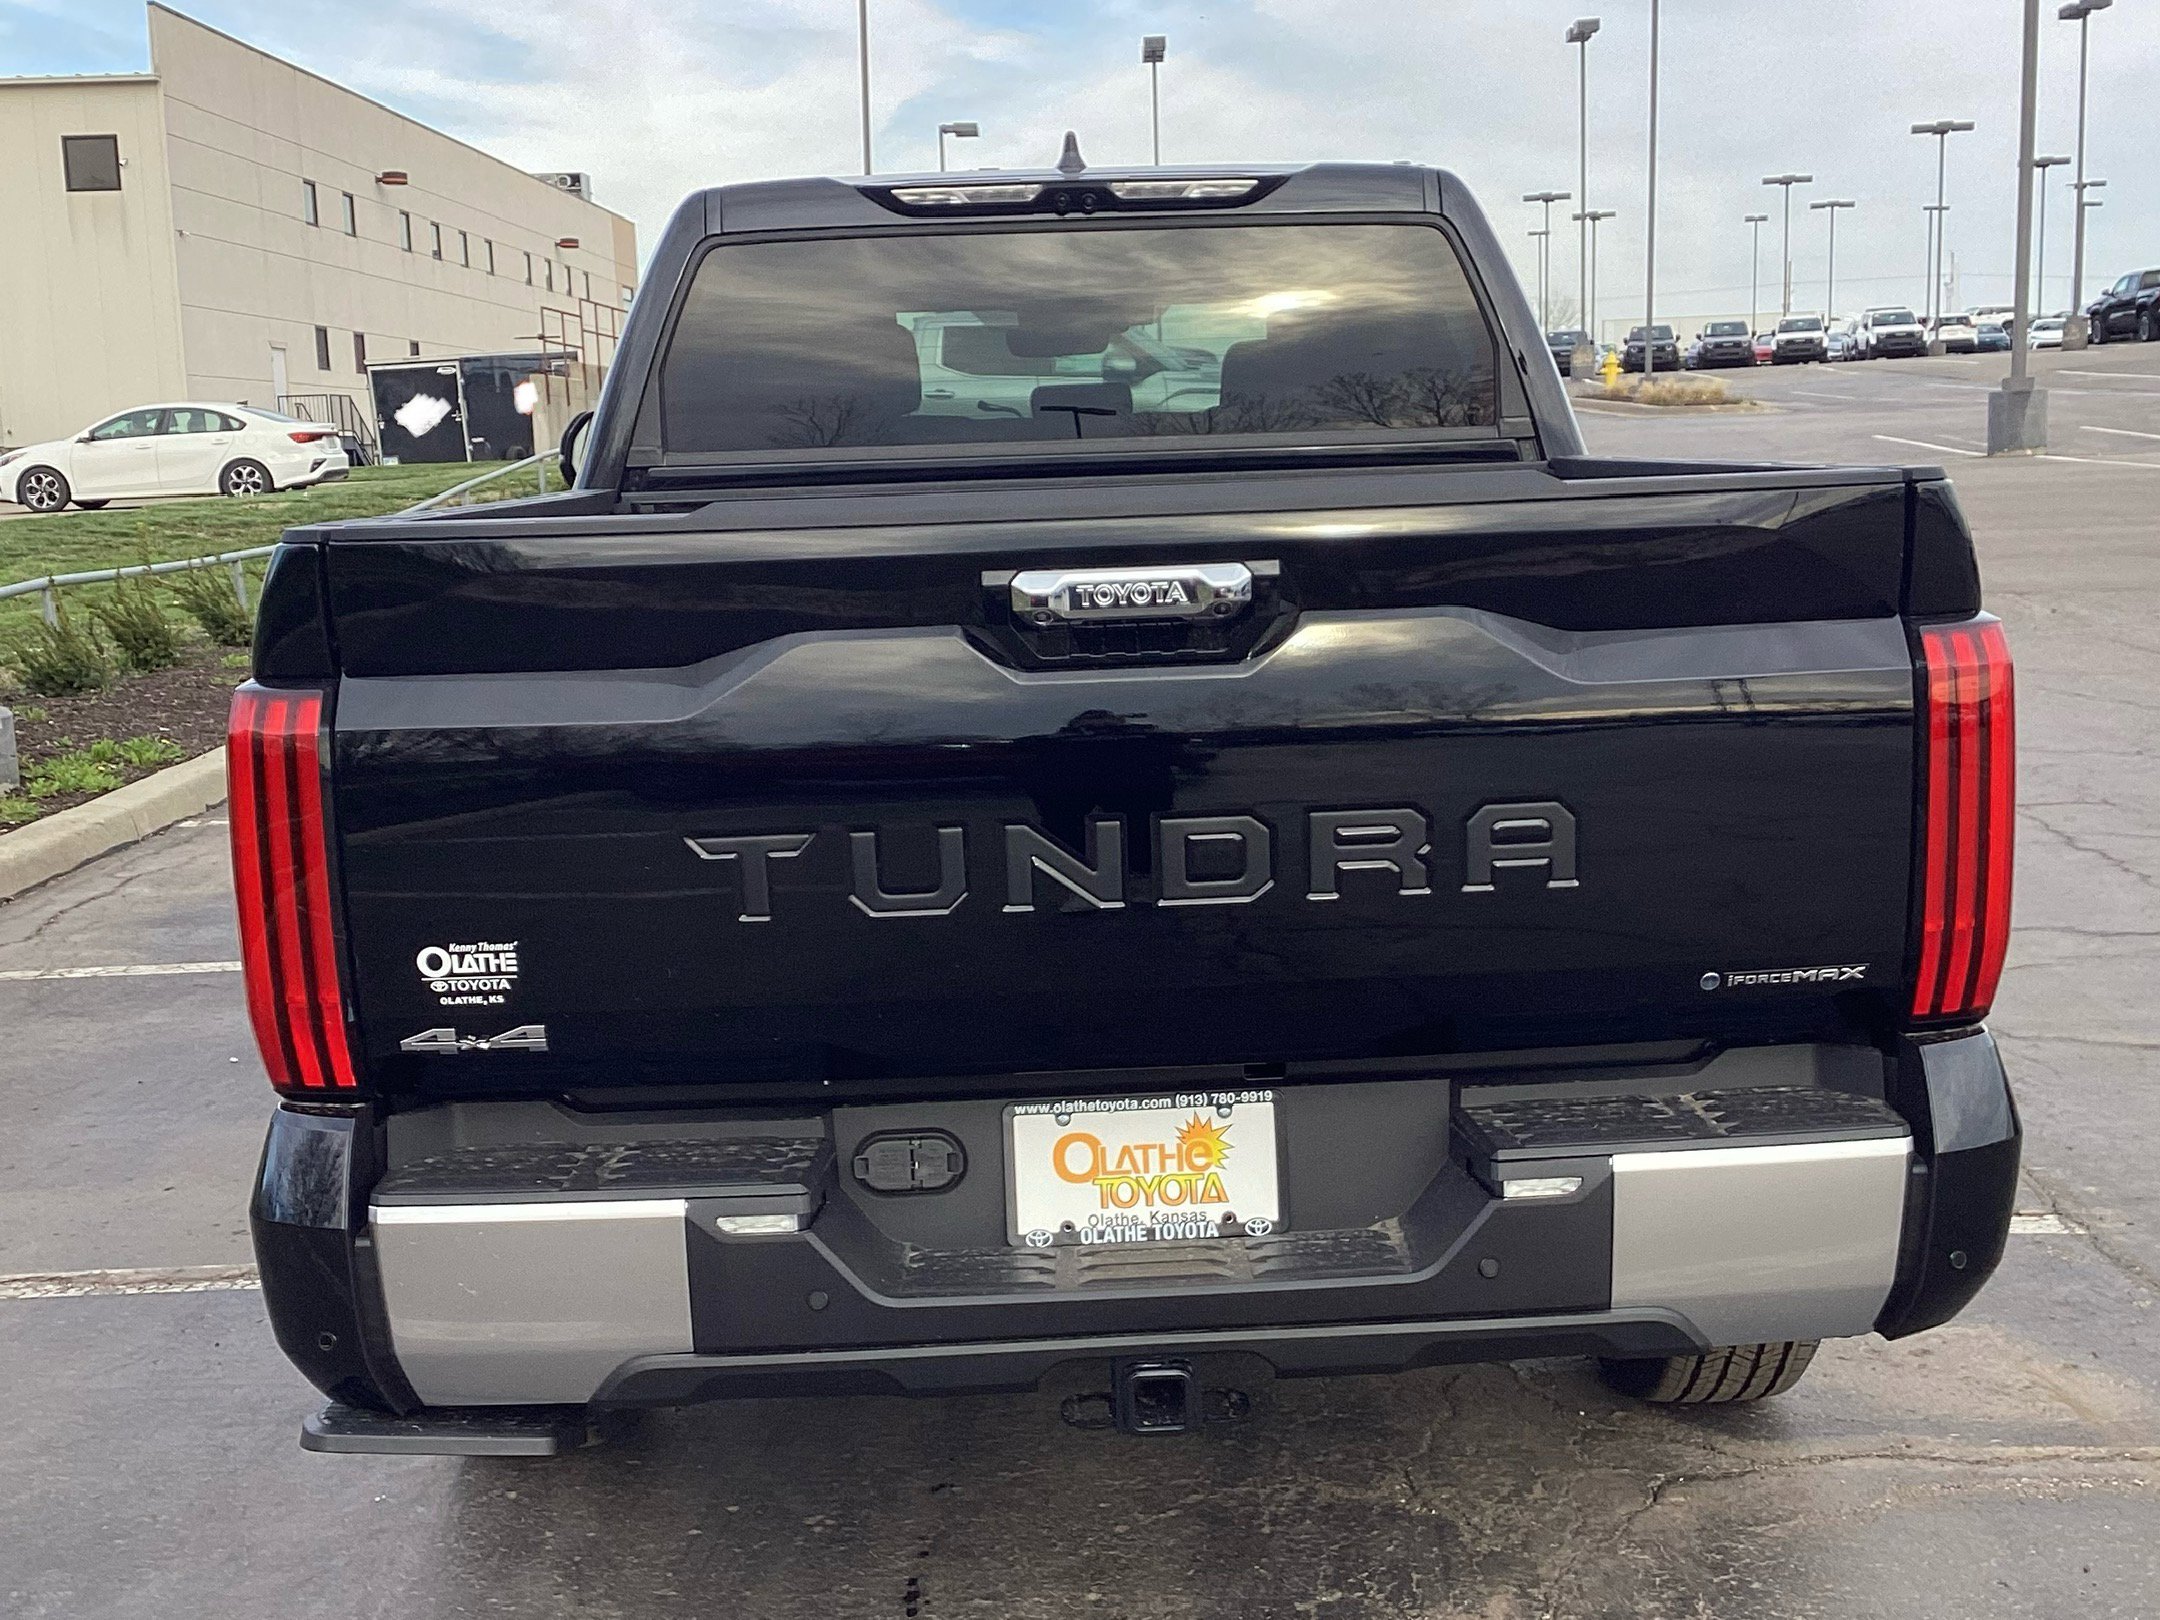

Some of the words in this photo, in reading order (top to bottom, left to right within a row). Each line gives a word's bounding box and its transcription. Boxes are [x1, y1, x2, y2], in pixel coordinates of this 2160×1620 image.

[1076, 581, 1188, 608] TOYOTA
[684, 801, 1579, 922] TUNDRA
[449, 943, 477, 953] Kenny
[416, 946, 518, 978] OLATHE
[448, 979, 511, 991] TOYOTA
[440, 996, 488, 1005] OLATHE,
[489, 995, 505, 1003] KS
[400, 1025, 549, 1055] 4x4
[1015, 1098, 1172, 1114] www.olathetoyota.com
[1175, 1093, 1208, 1108] (913)
[1210, 1090, 1273, 1105] 780-9919
[1093, 1172, 1229, 1208] TOYOTA
[1151, 1210, 1207, 1224] Kansas
[1080, 1225, 1148, 1245] OLATHE
[1152, 1221, 1219, 1241] TOYOTA
